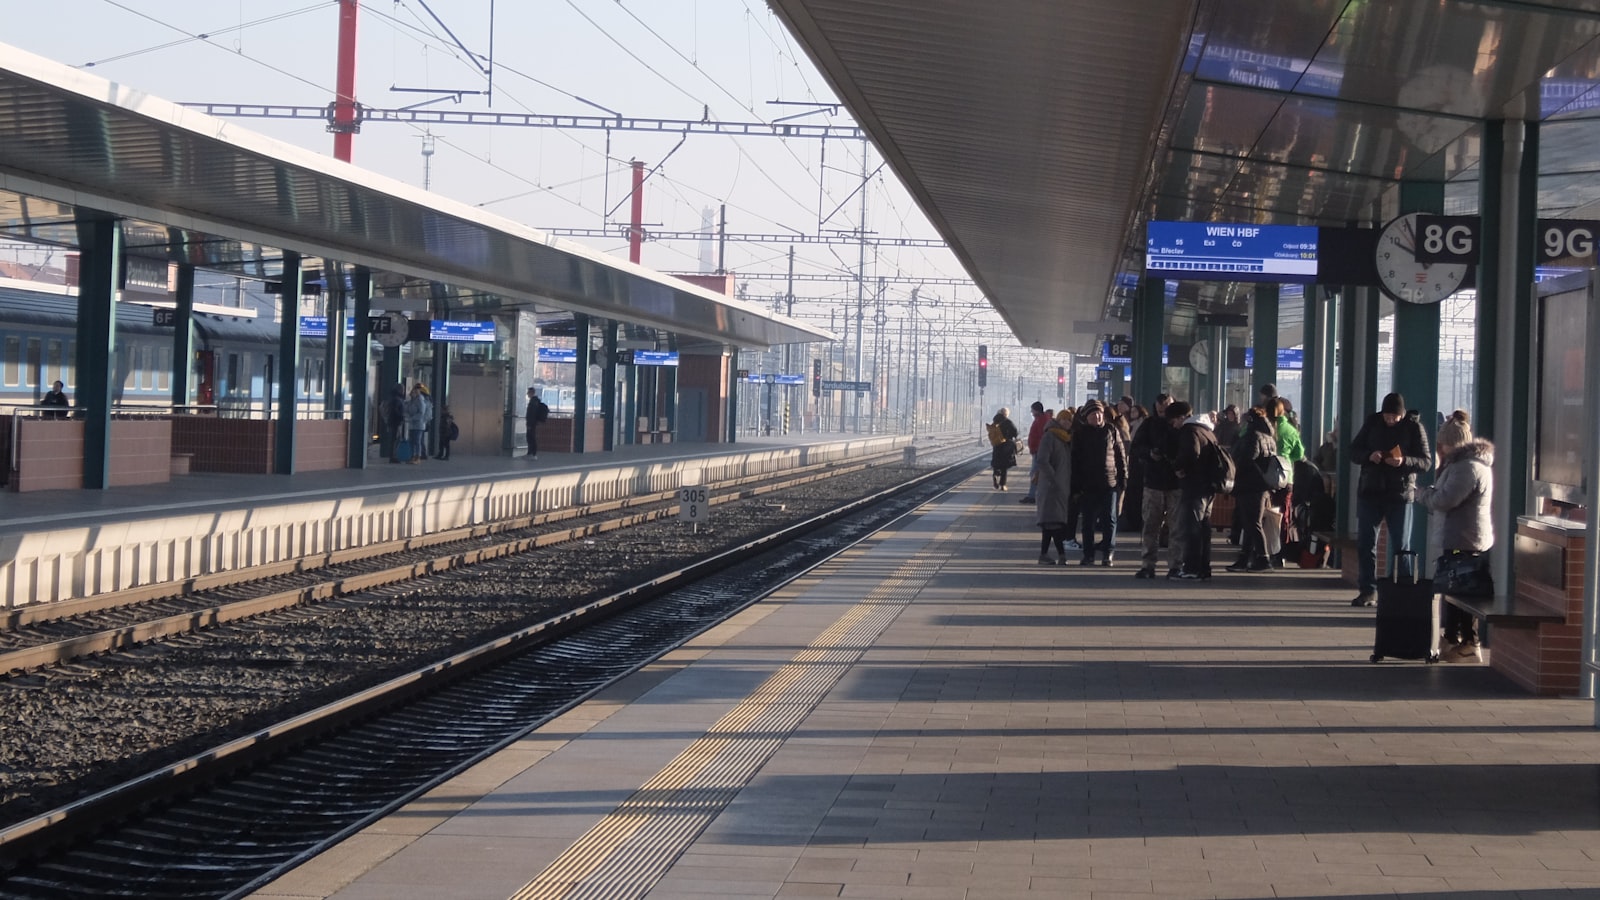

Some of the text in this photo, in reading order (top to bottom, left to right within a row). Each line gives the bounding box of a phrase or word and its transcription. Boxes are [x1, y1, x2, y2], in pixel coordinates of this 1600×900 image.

[1206, 226, 1260, 238] WIEN HBF
[1423, 224, 1473, 255] 8G
[1544, 228, 1594, 258] 9G
[156, 312, 173, 324] 6F
[371, 319, 390, 331] 7F
[1112, 344, 1128, 356] 8F
[682, 489, 705, 503] 305
[690, 504, 697, 518] 8
